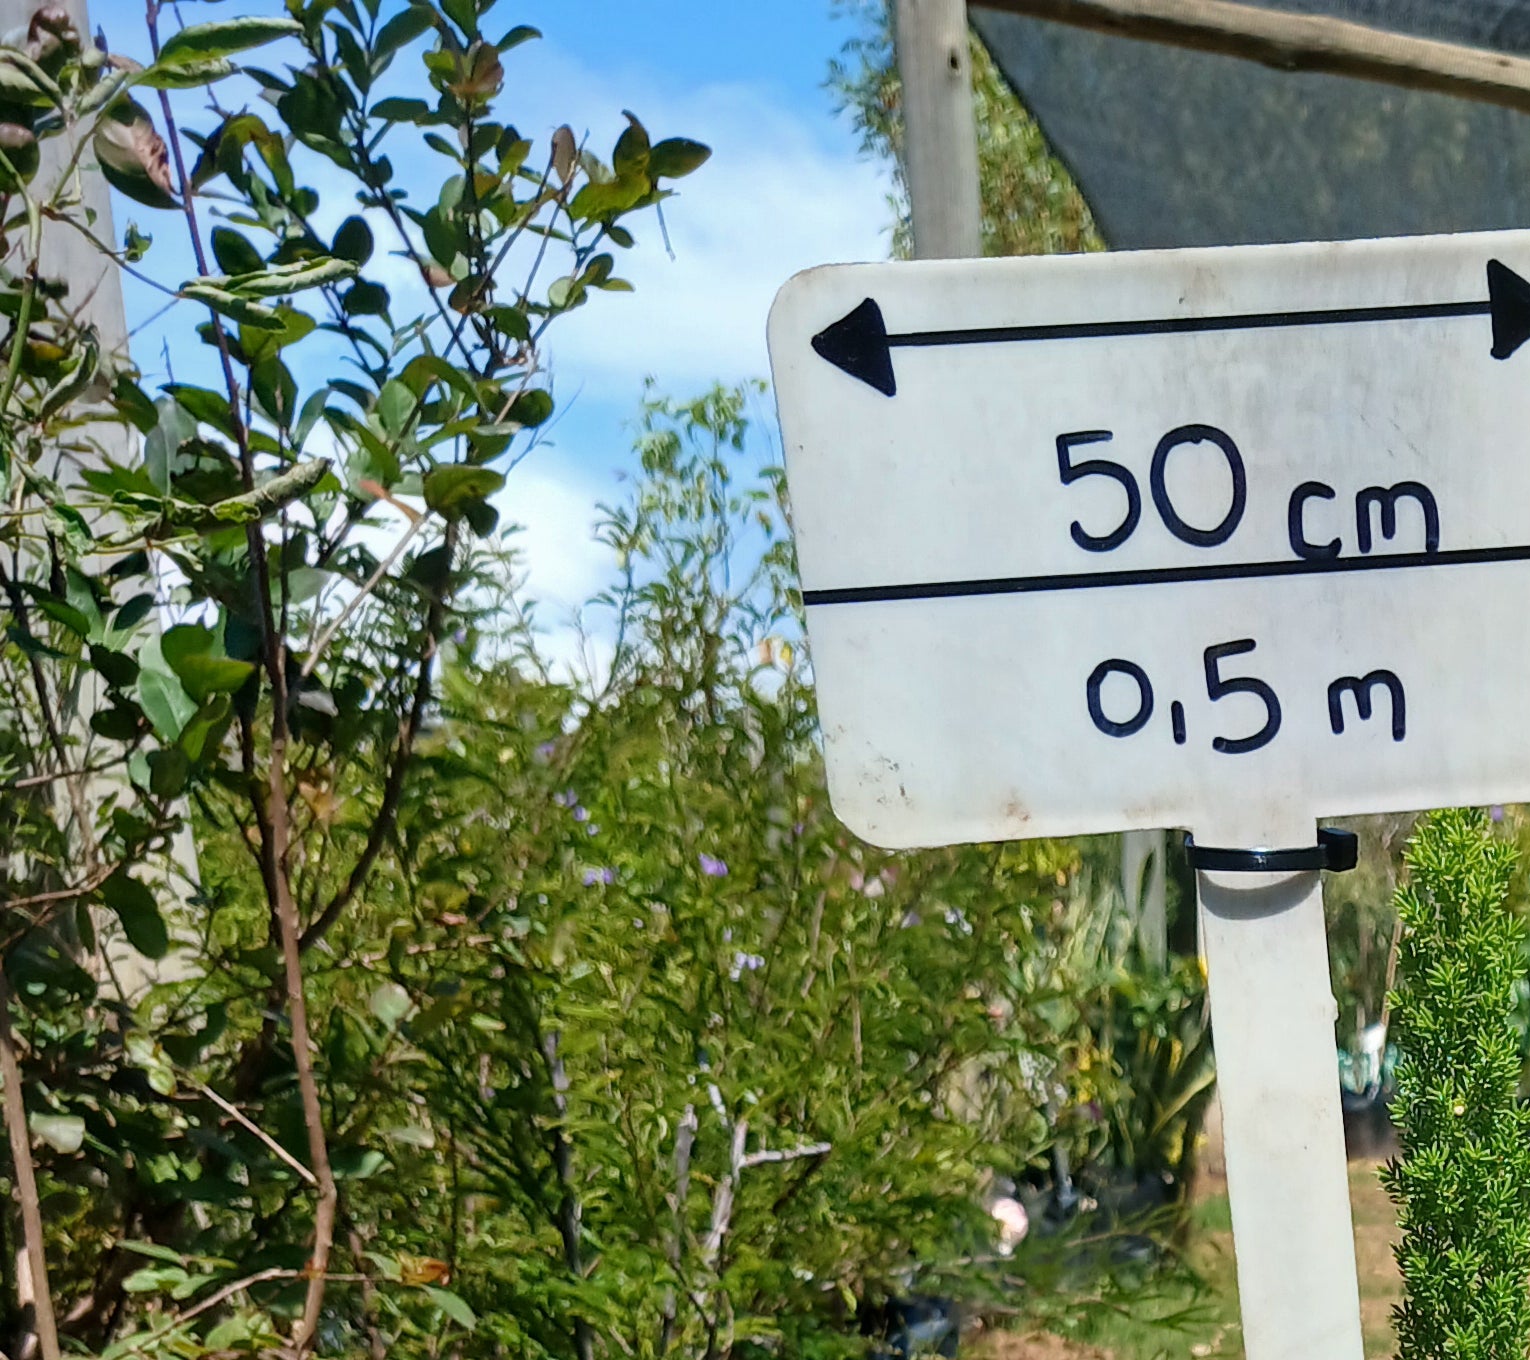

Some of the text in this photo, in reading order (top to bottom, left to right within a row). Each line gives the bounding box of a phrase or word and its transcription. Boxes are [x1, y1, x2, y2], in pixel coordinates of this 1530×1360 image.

[1055, 422, 1440, 560] 50 cm
[1086, 638, 1406, 754] 0,5 m
